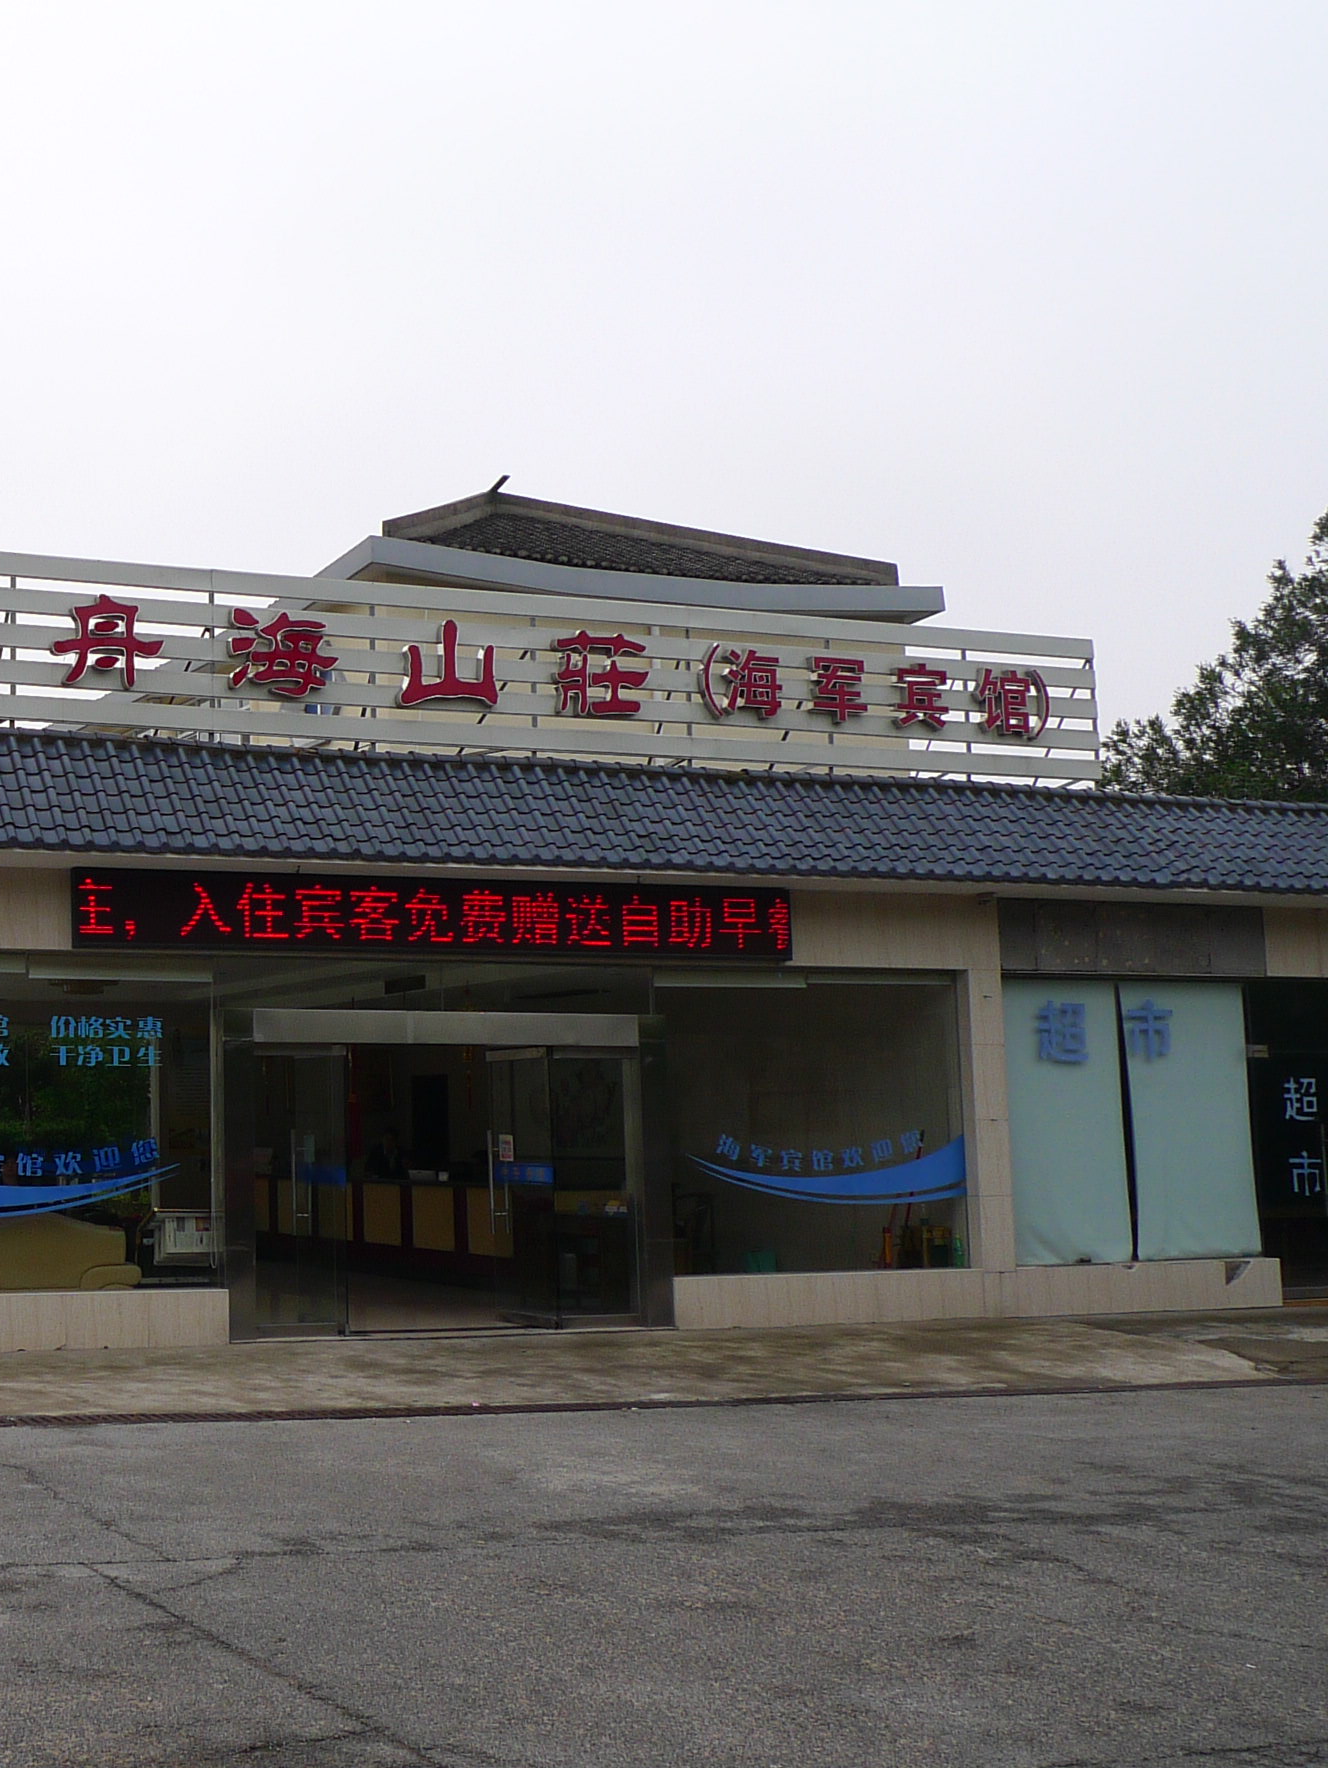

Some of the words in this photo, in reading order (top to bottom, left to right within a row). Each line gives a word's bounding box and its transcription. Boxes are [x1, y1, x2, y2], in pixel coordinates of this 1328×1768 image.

[50, 1015, 164, 1039] 价格实惠
[1037, 1000, 1172, 1063] 超市
[50, 1045, 163, 1067] 干净卫生
[715, 1129, 923, 1172] 海军宾馆欢迎您
[1283, 1076, 1322, 1196] 超市
